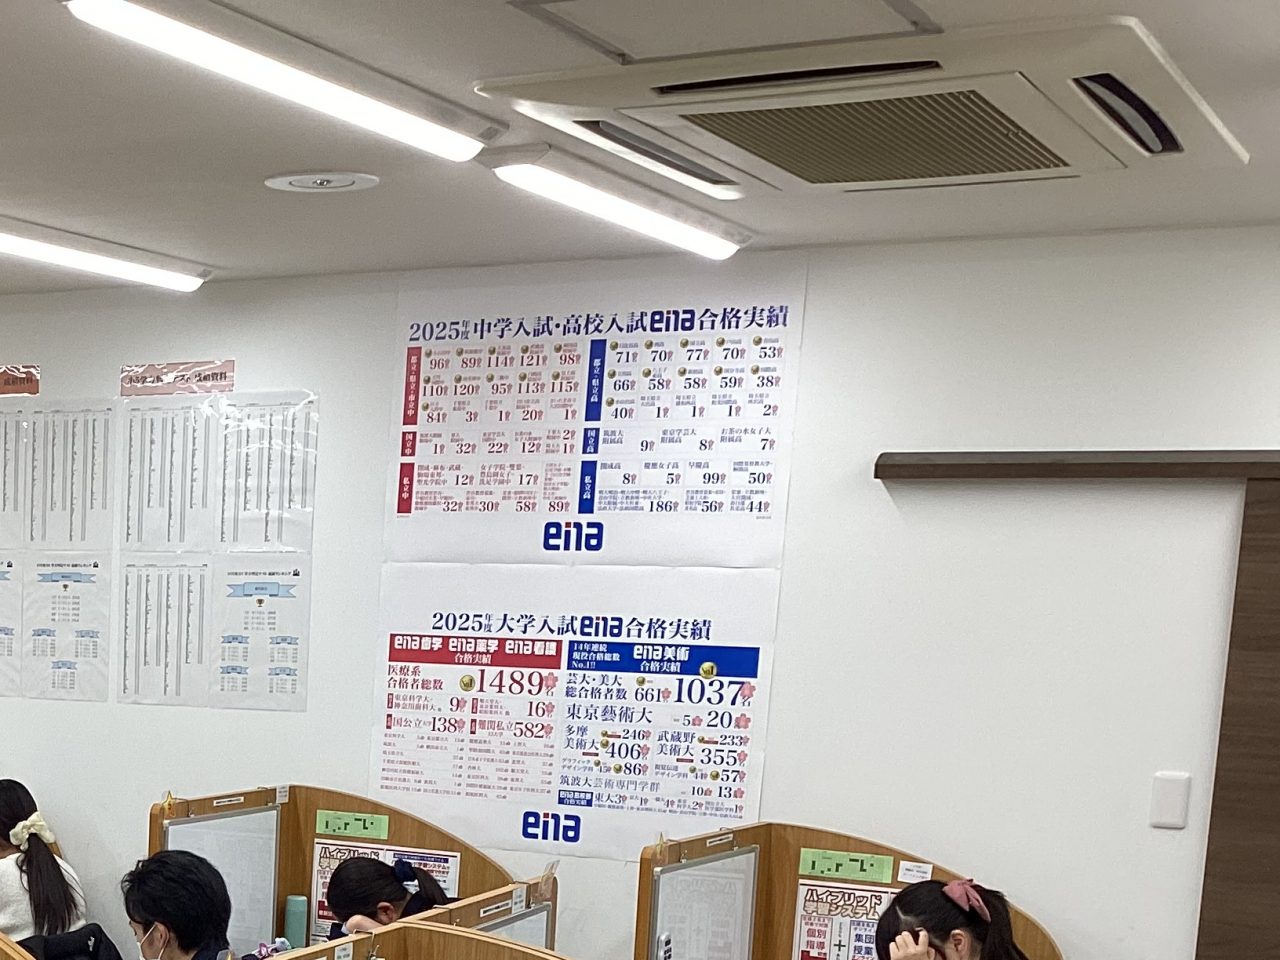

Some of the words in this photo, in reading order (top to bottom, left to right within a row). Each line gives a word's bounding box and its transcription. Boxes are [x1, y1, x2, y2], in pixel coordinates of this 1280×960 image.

[616, 351, 631, 363] 71
[651, 350, 667, 361] 70
[686, 349, 703, 361] 77
[723, 348, 739, 360] 70
[759, 347, 776, 358] 53
[430, 359, 445, 370] 96
[487, 356, 509, 368] 114
[520, 356, 541, 367] 121
[560, 354, 574, 365] 98
[614, 380, 630, 391] 66
[648, 379, 665, 390] 58
[684, 378, 701, 390] 58
[720, 377, 737, 389] 59
[757, 376, 774, 388] 38
[422, 385, 443, 397] 110
[453, 384, 475, 396] 120
[492, 384, 506, 395] 95
[522, 410, 537, 421] 20
[611, 407, 628, 419] 40
[703, 473, 720, 485] 99
[748, 472, 765, 484] 50
[548, 501, 564, 512] 89
[649, 501, 673, 513] 186
[746, 501, 763, 513] 44
[542, 521, 604, 551] ena
[633, 645, 690, 661] ena美術
[388, 664, 421, 677] 医療系
[640, 661, 681, 673] 合格実績
[388, 677, 443, 691] 合格者総数
[476, 668, 545, 696] 1489
[566, 673, 622, 686] 芸大・美大
[565, 686, 627, 701] 総合格者数
[634, 688, 661, 703] 661
[673, 677, 743, 706] 1037
[450, 697, 459, 712] 9
[528, 702, 545, 718] 16
[566, 703, 653, 724] 東京藝術大
[706, 710, 732, 729] 20
[431, 716, 458, 733] 138
[682, 715, 691, 726] 5
[513, 721, 545, 739] 582
[566, 724, 588, 738] 多摩
[623, 728, 645, 740] 246
[657, 731, 696, 743] 武蔵野
[719, 735, 743, 747] 233
[565, 738, 599, 751] 美術大
[657, 743, 694, 757] 美術大
[605, 742, 641, 760] 406
[700, 748, 738, 766] 355
[623, 762, 641, 776] 86
[720, 768, 739, 783] 57
[691, 786, 704, 797] 10
[718, 786, 732, 799] 13
[521, 810, 581, 843] ena
[805, 889, 882, 908] ハイブリッド
[804, 901, 880, 920] 学習システム
